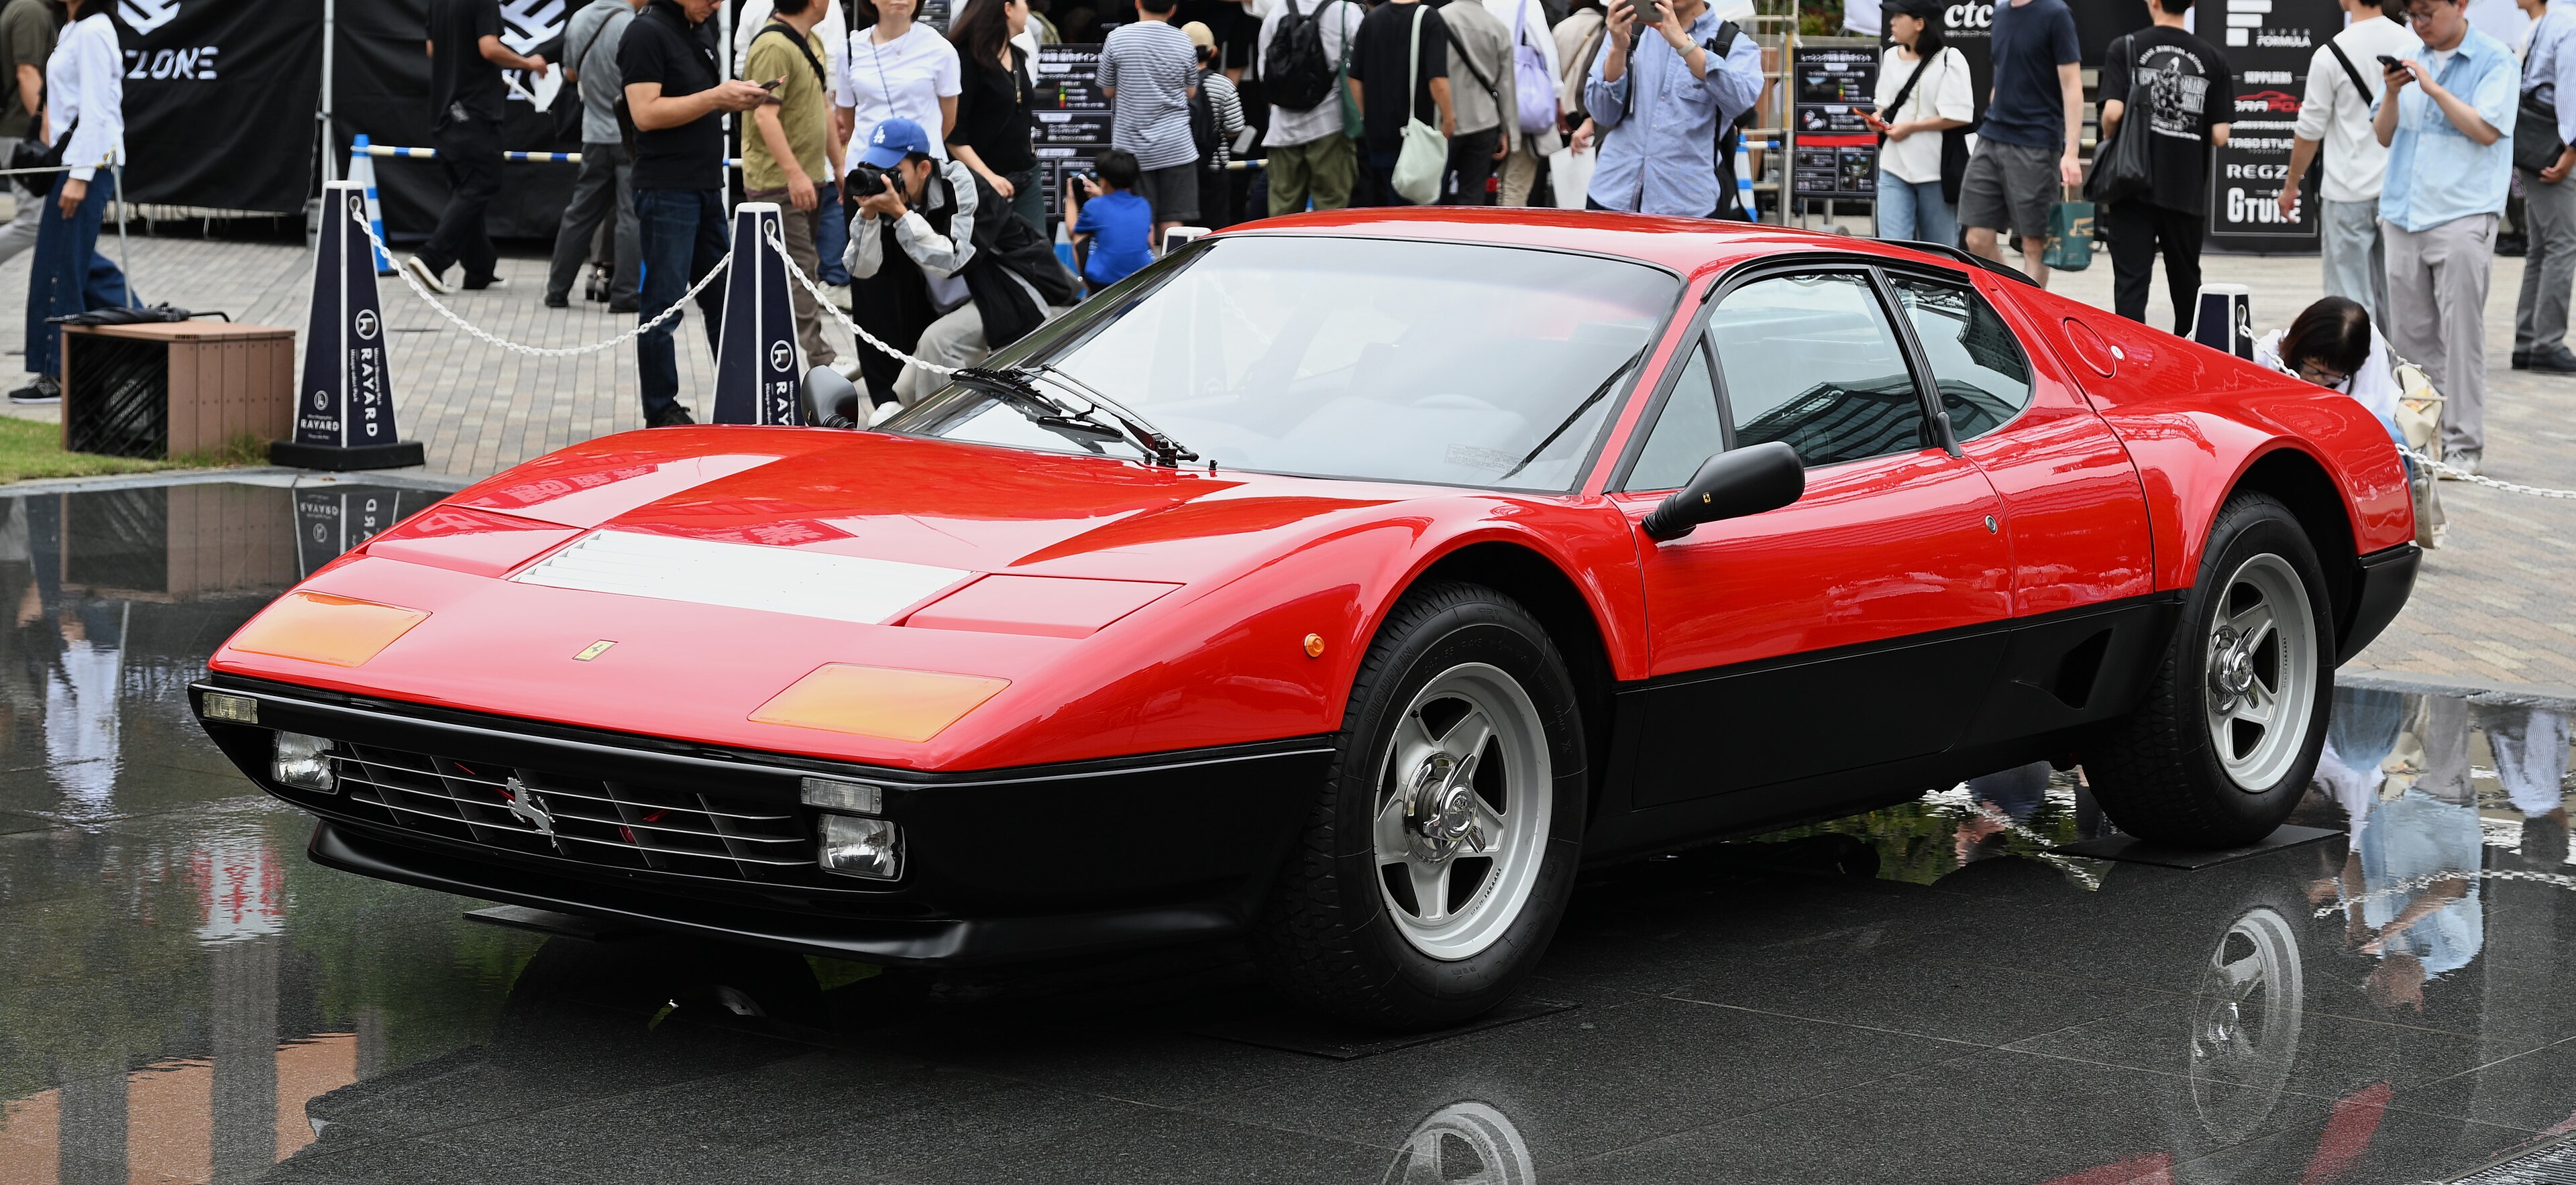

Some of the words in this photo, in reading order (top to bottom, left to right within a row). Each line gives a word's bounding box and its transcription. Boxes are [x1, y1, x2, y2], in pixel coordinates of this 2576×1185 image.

[1943, 0, 1994, 28] ctc
[2256, 36, 2312, 47] FORMULA
[2257, 28, 2311, 36] SUPER
[125, 46, 219, 79] ZONE
[2226, 164, 2305, 180] REGZ
[361, 348, 378, 437] RAYARD
[300, 418, 340, 431] RAYARD
[1364, 646, 1415, 726] MICHELIN
